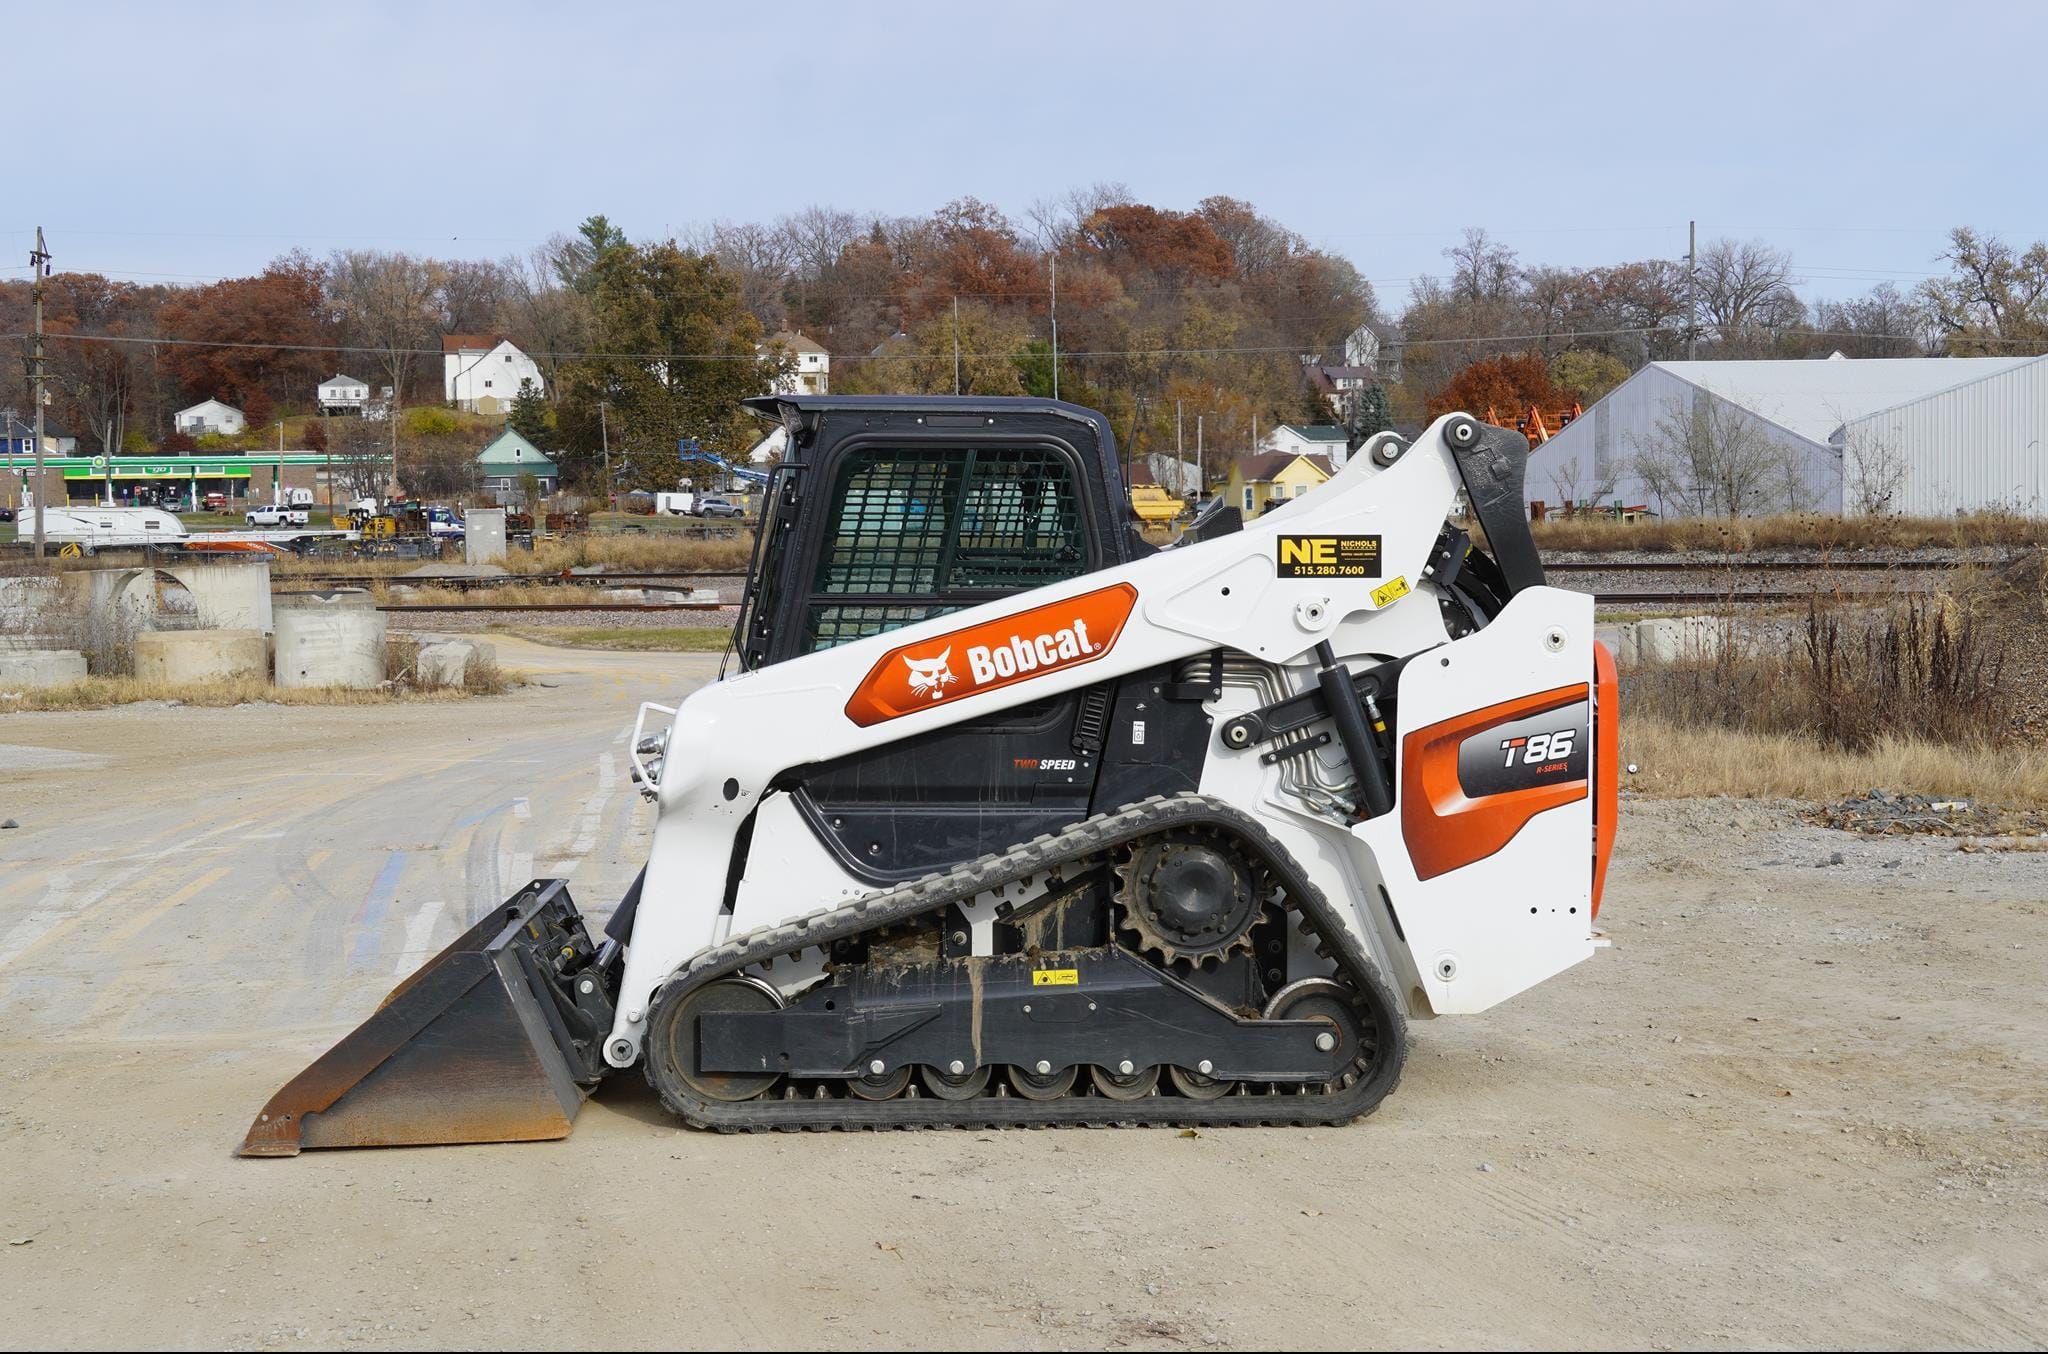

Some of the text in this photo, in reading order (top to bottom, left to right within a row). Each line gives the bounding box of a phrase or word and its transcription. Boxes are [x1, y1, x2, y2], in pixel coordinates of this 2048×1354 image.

[1281, 538, 1337, 564] NE
[1294, 566, 1365, 575] 515.280.7600
[966, 618, 1093, 685] Bobcat
[1501, 729, 1576, 768] T86
[1013, 759, 1076, 770] TWO SPEED
